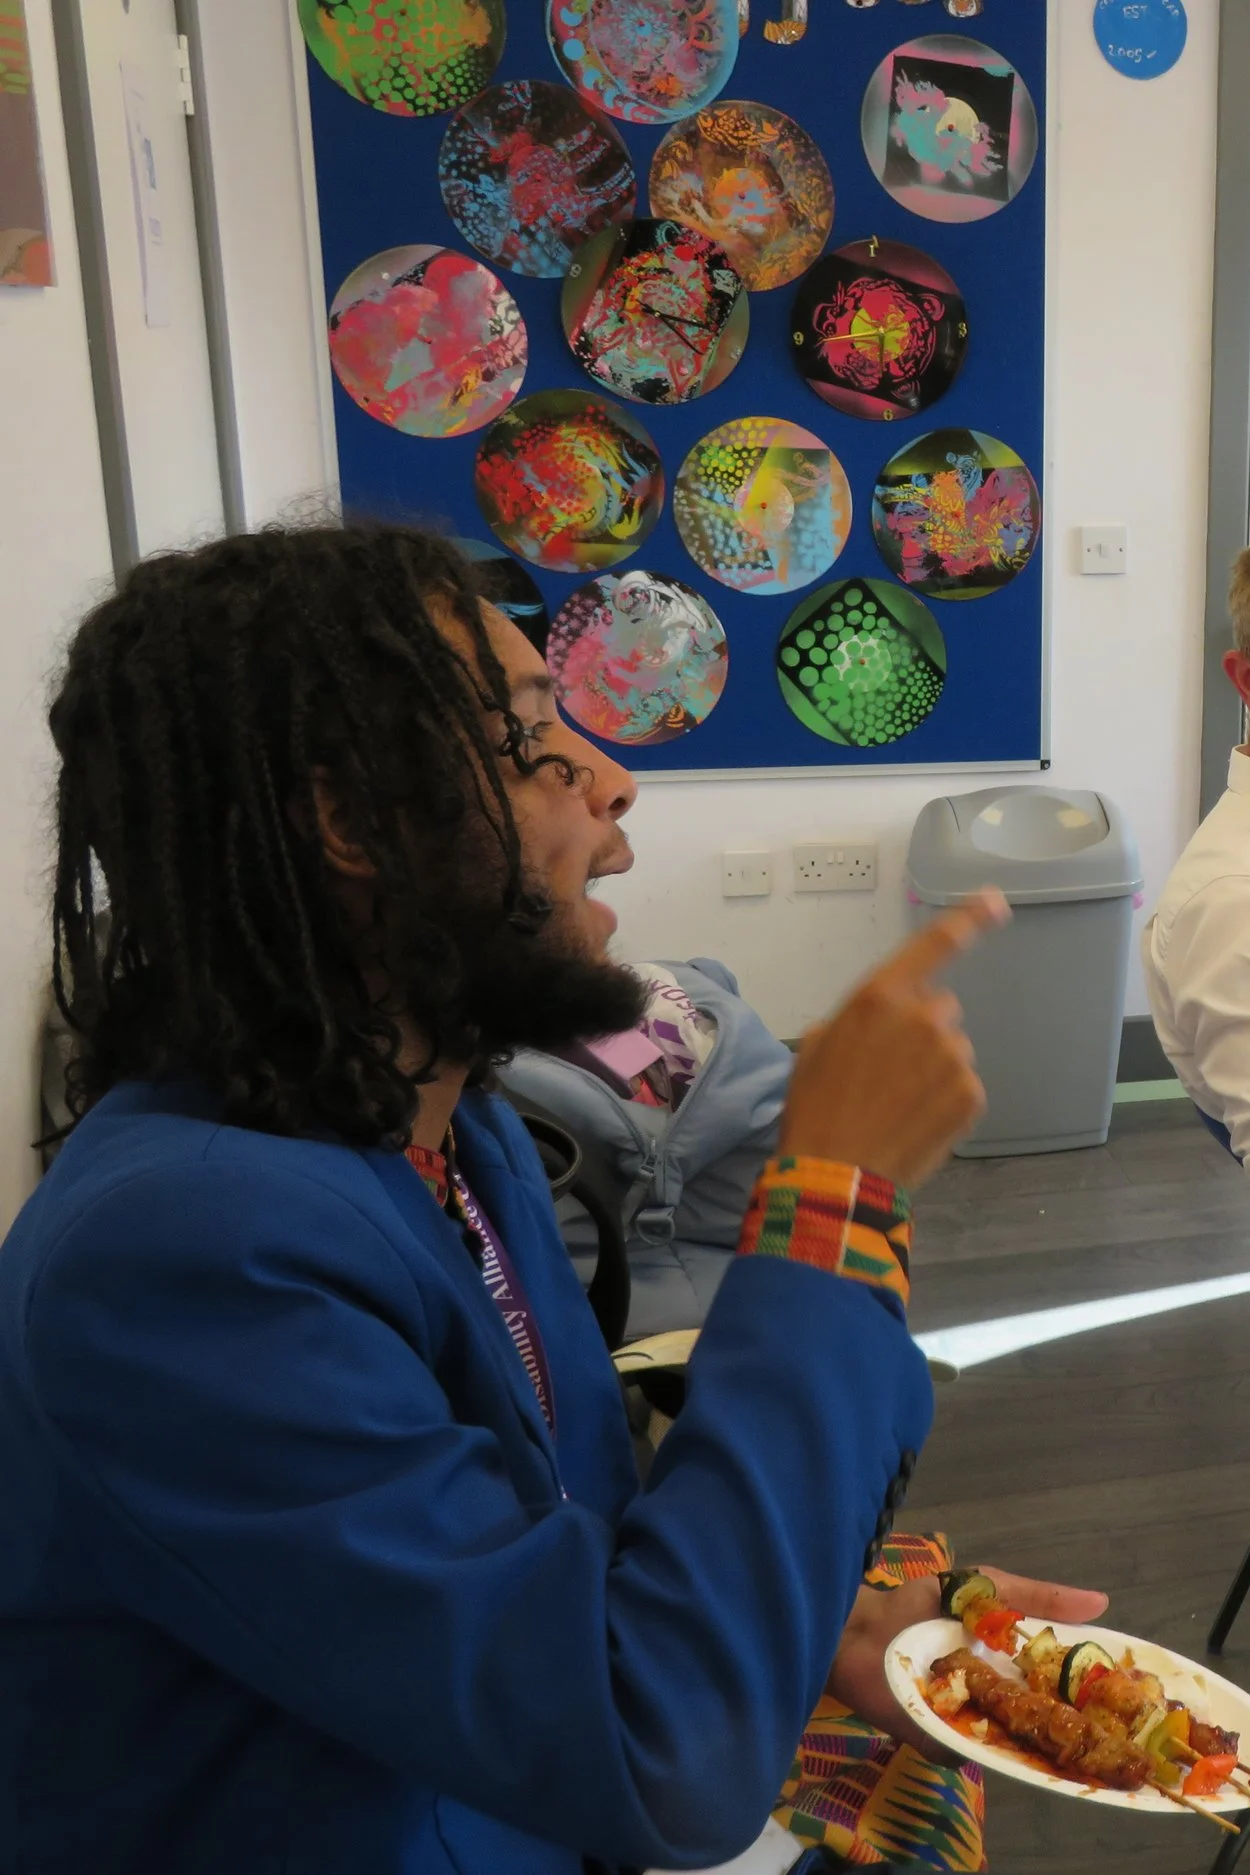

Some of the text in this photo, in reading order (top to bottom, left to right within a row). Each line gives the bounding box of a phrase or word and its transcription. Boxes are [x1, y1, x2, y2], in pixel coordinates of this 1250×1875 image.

[958, 322, 968, 338] 3
[793, 331, 804, 345] 9
[883, 408, 894, 422] 6
